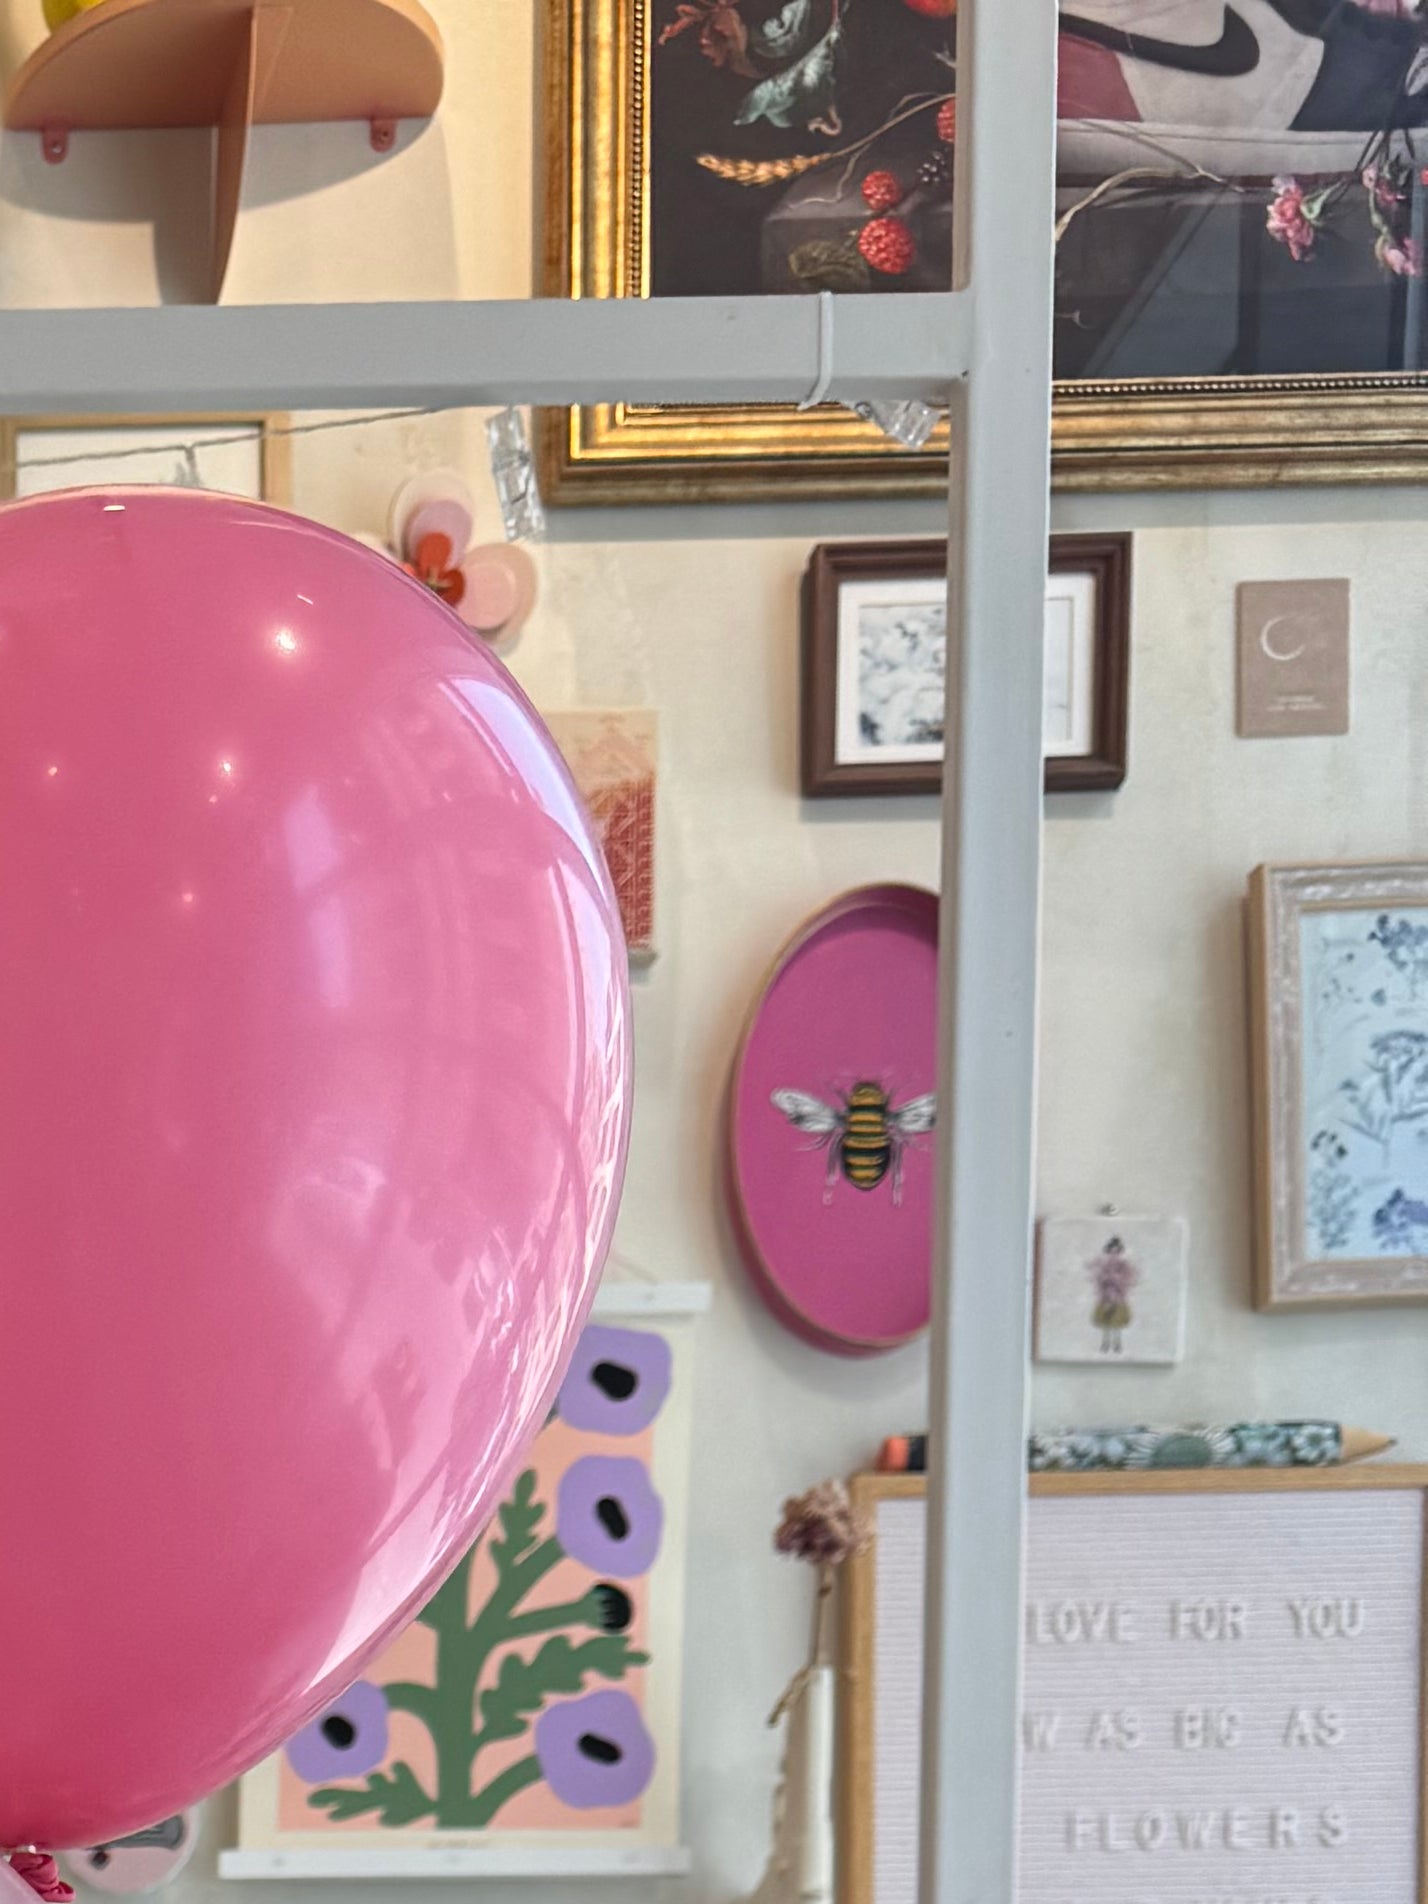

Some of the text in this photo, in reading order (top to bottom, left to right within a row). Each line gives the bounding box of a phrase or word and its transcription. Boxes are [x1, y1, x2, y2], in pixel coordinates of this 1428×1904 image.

[1025, 1598, 1365, 1645] LOVE FOR YOU
[1085, 1707, 1143, 1751] AS
[1173, 1705, 1244, 1750] BIG
[1282, 1704, 1346, 1748] AS
[1064, 1805, 1349, 1852] FLOWERS
